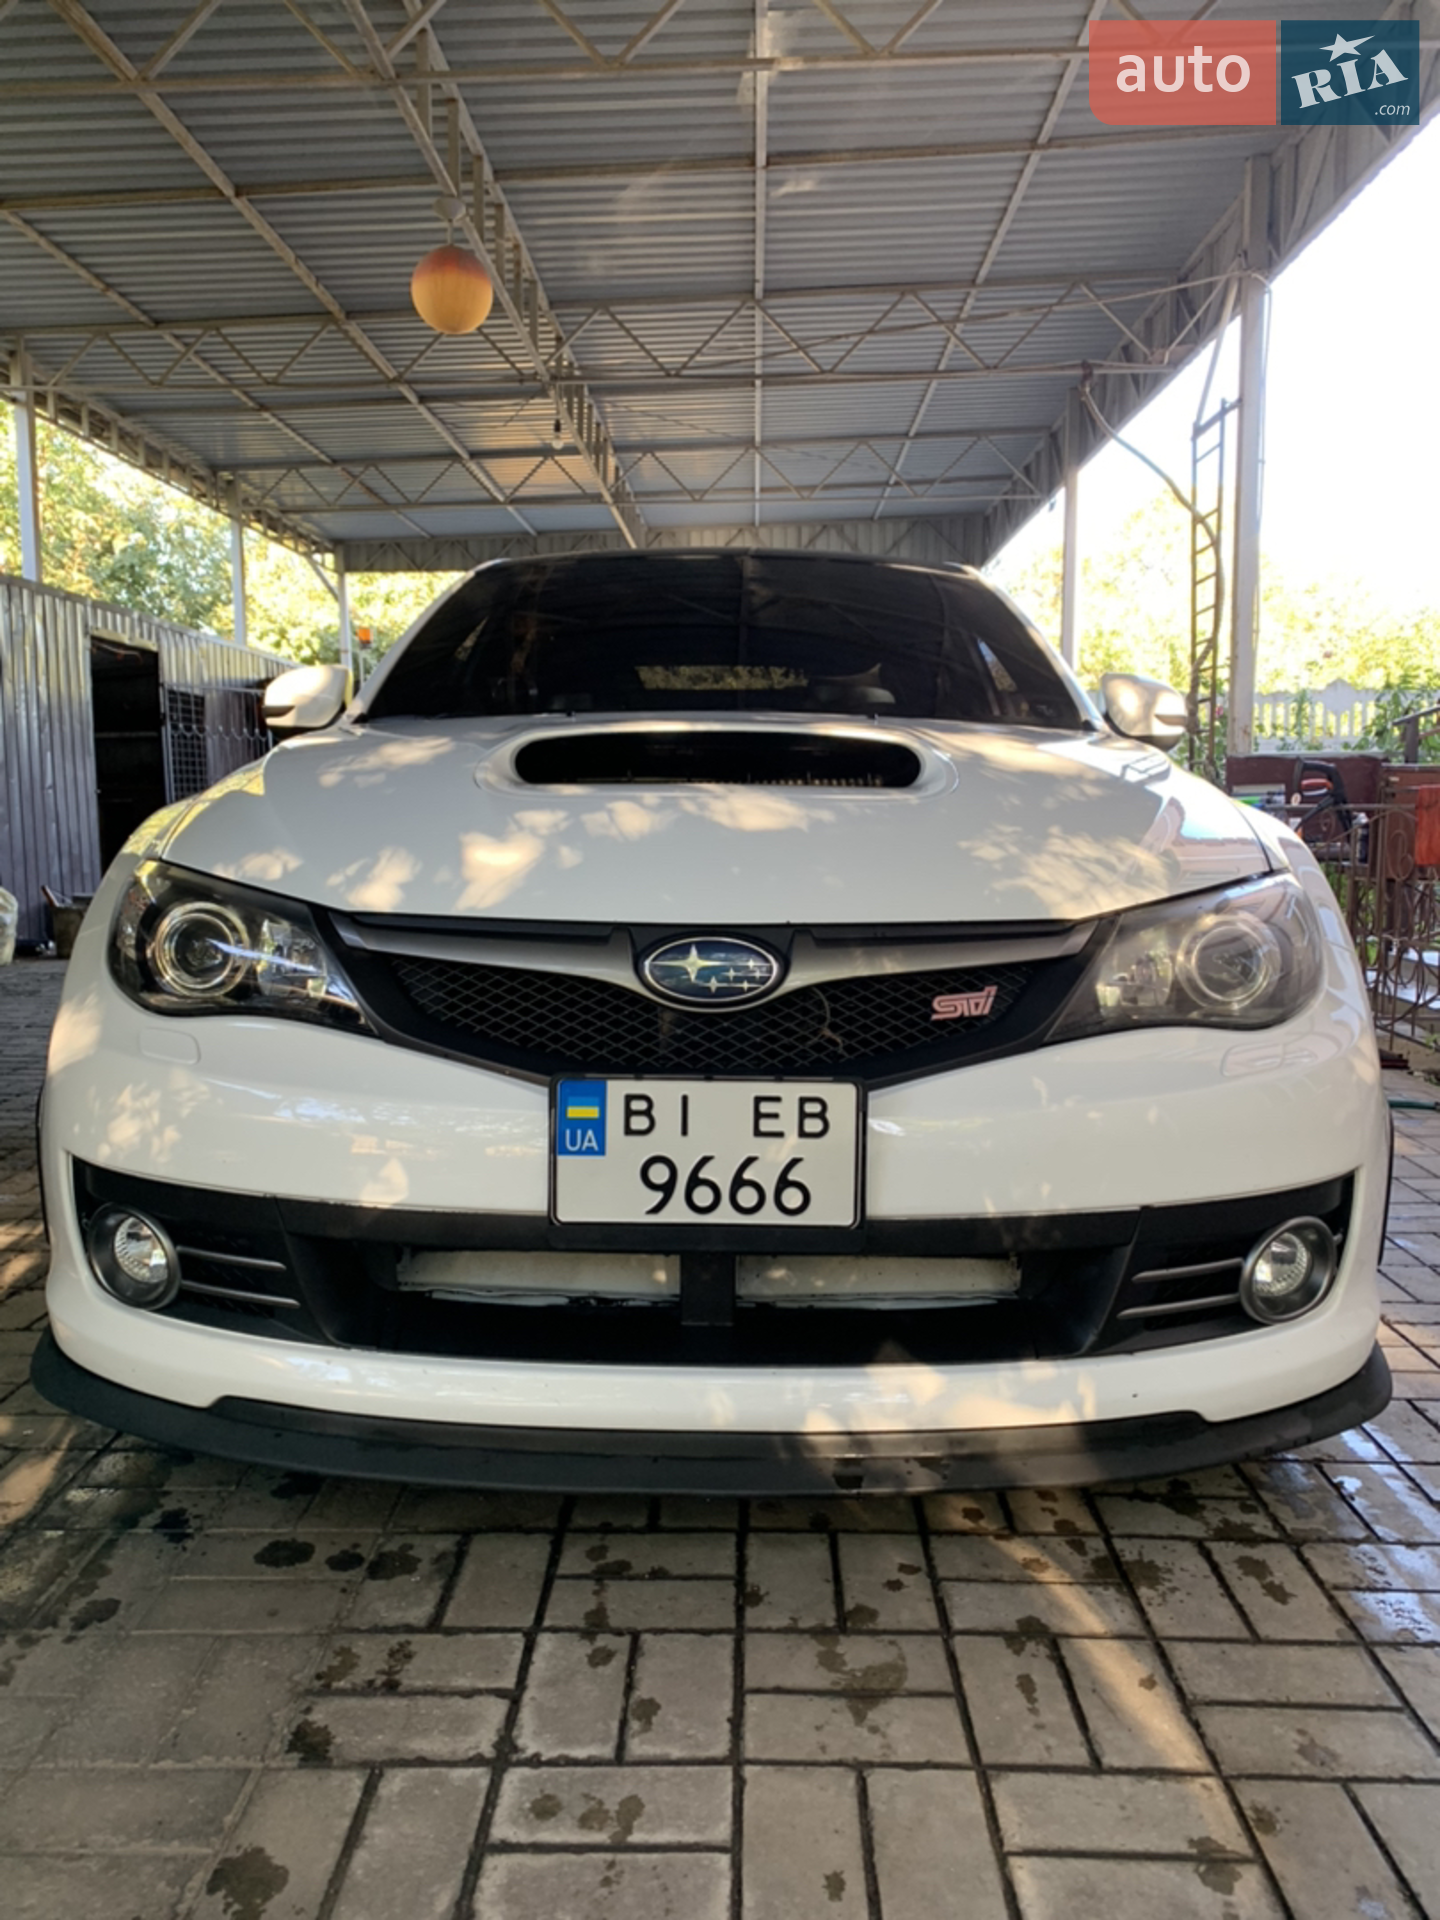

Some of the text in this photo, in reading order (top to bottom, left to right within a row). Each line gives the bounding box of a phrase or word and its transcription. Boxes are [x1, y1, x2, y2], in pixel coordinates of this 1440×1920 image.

[753, 1095, 830, 1139] EB
[565, 1129, 599, 1151] UA
[640, 1154, 811, 1216] 9666
